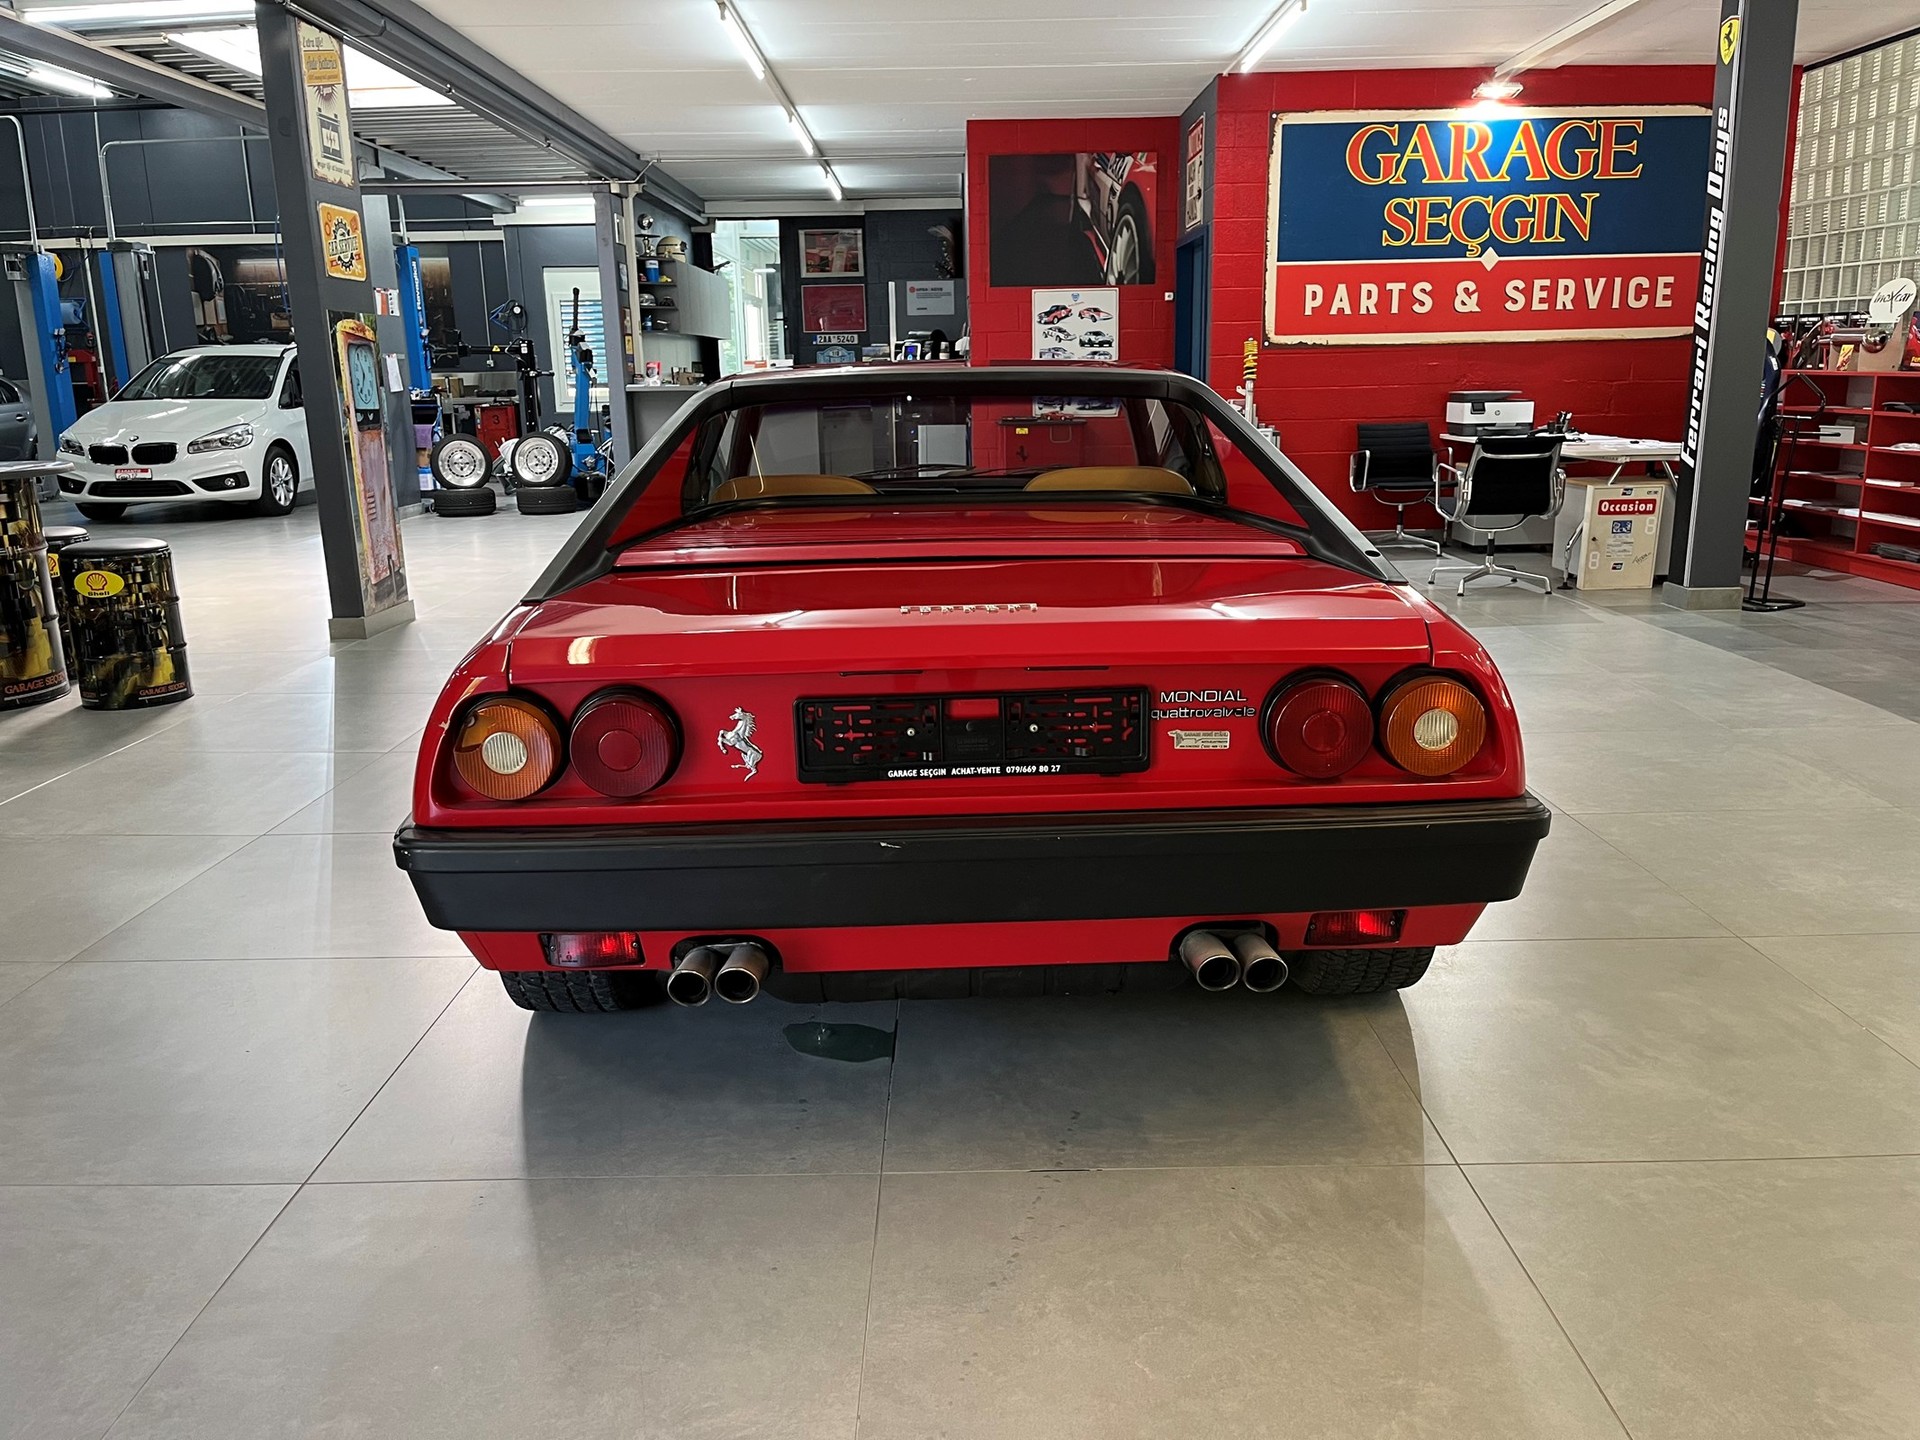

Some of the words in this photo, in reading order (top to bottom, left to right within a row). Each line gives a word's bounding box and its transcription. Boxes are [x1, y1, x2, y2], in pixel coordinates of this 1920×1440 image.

[1346, 119, 1643, 185] GARAGE
[1706, 106, 1730, 199] Days
[1382, 193, 1600, 257] SEÇGIN
[1694, 206, 1724, 331] Racing
[1303, 281, 1434, 316] PARTS
[1453, 280, 1482, 313] &
[1504, 276, 1676, 312] SERVICE
[1681, 334, 1708, 469] Ferrari
[1601, 500, 1654, 512] Occasion
[4, 678, 44, 695] GARAGE
[139, 685, 167, 696] GARAGE
[1160, 689, 1247, 703] MONDIAL
[888, 769, 917, 778] GARAGE
[919, 768, 946, 778] SEÇGIN
[951, 766, 1001, 775] ACHAT-VENTE
[1005, 765, 1037, 774] 079/669
[1039, 765, 1049, 773] 80
[1050, 764, 1061, 773] 27
